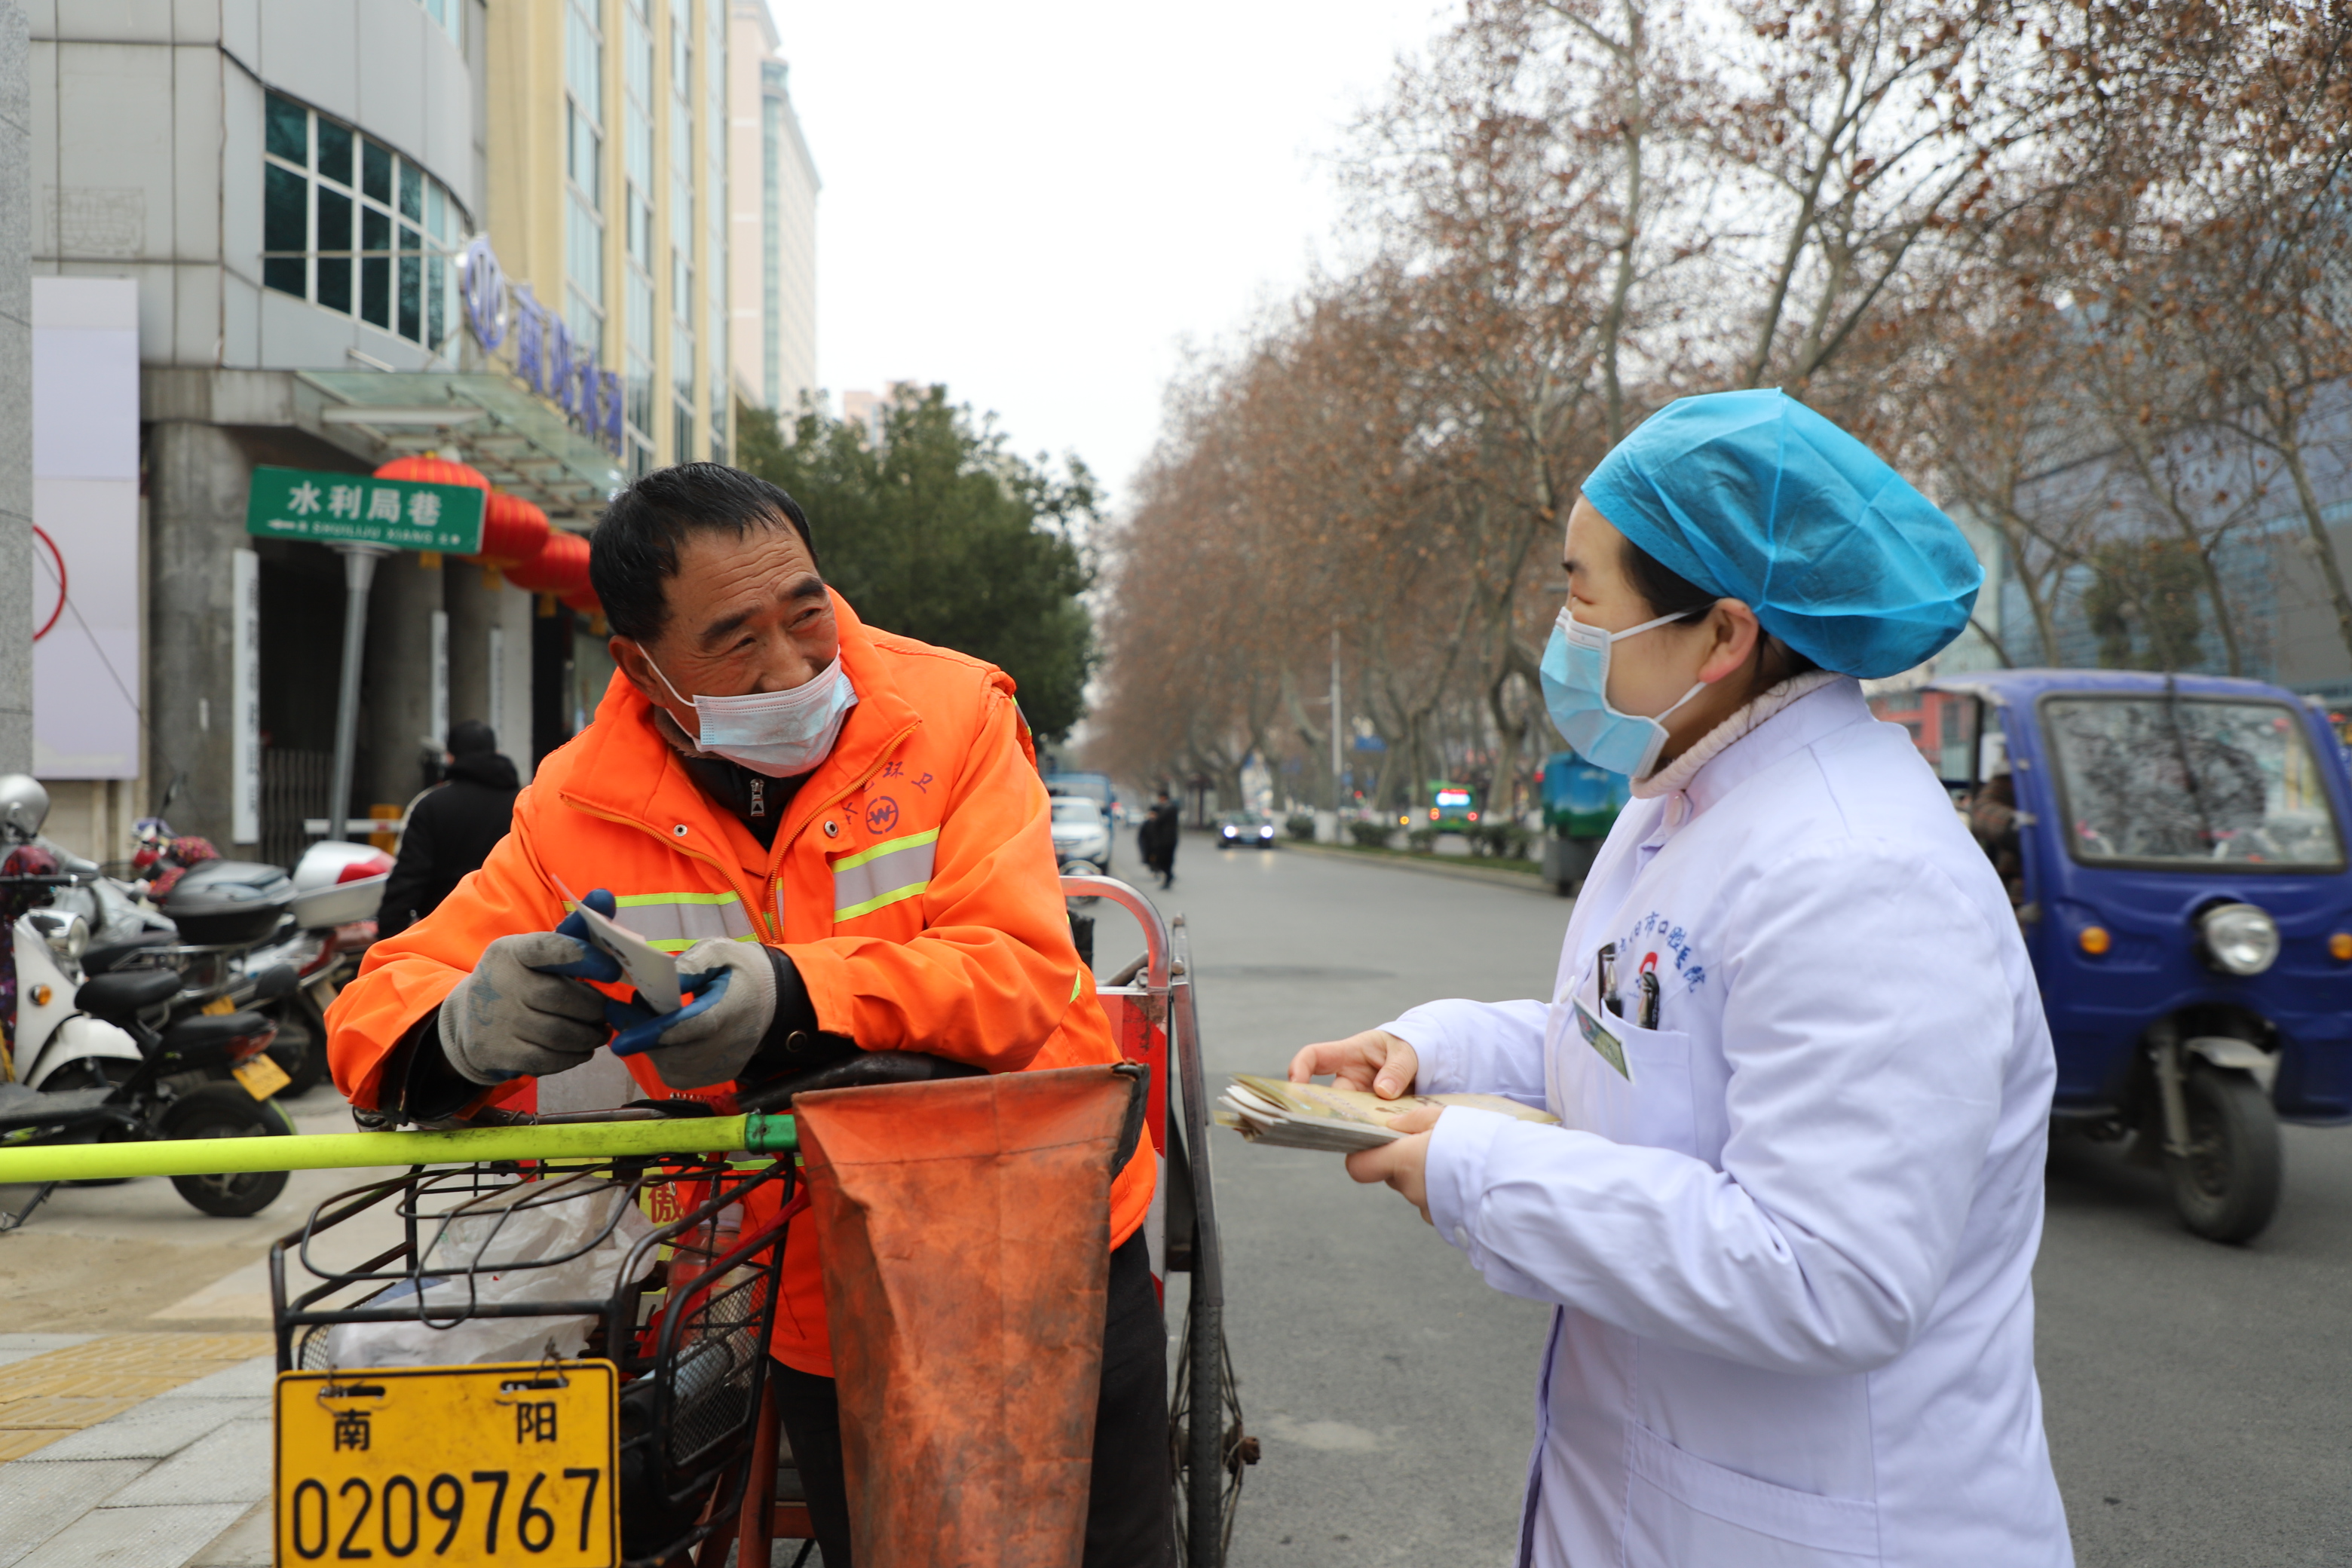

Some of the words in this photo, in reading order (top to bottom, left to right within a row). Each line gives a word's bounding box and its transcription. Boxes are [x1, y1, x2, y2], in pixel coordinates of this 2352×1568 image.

[287, 480, 442, 527] 水利局巷
[385, 528, 434, 544] XIANG
[333, 1408, 372, 1452] 南
[516, 1401, 557, 1444] 阳
[292, 1467, 600, 1560] 0209767
